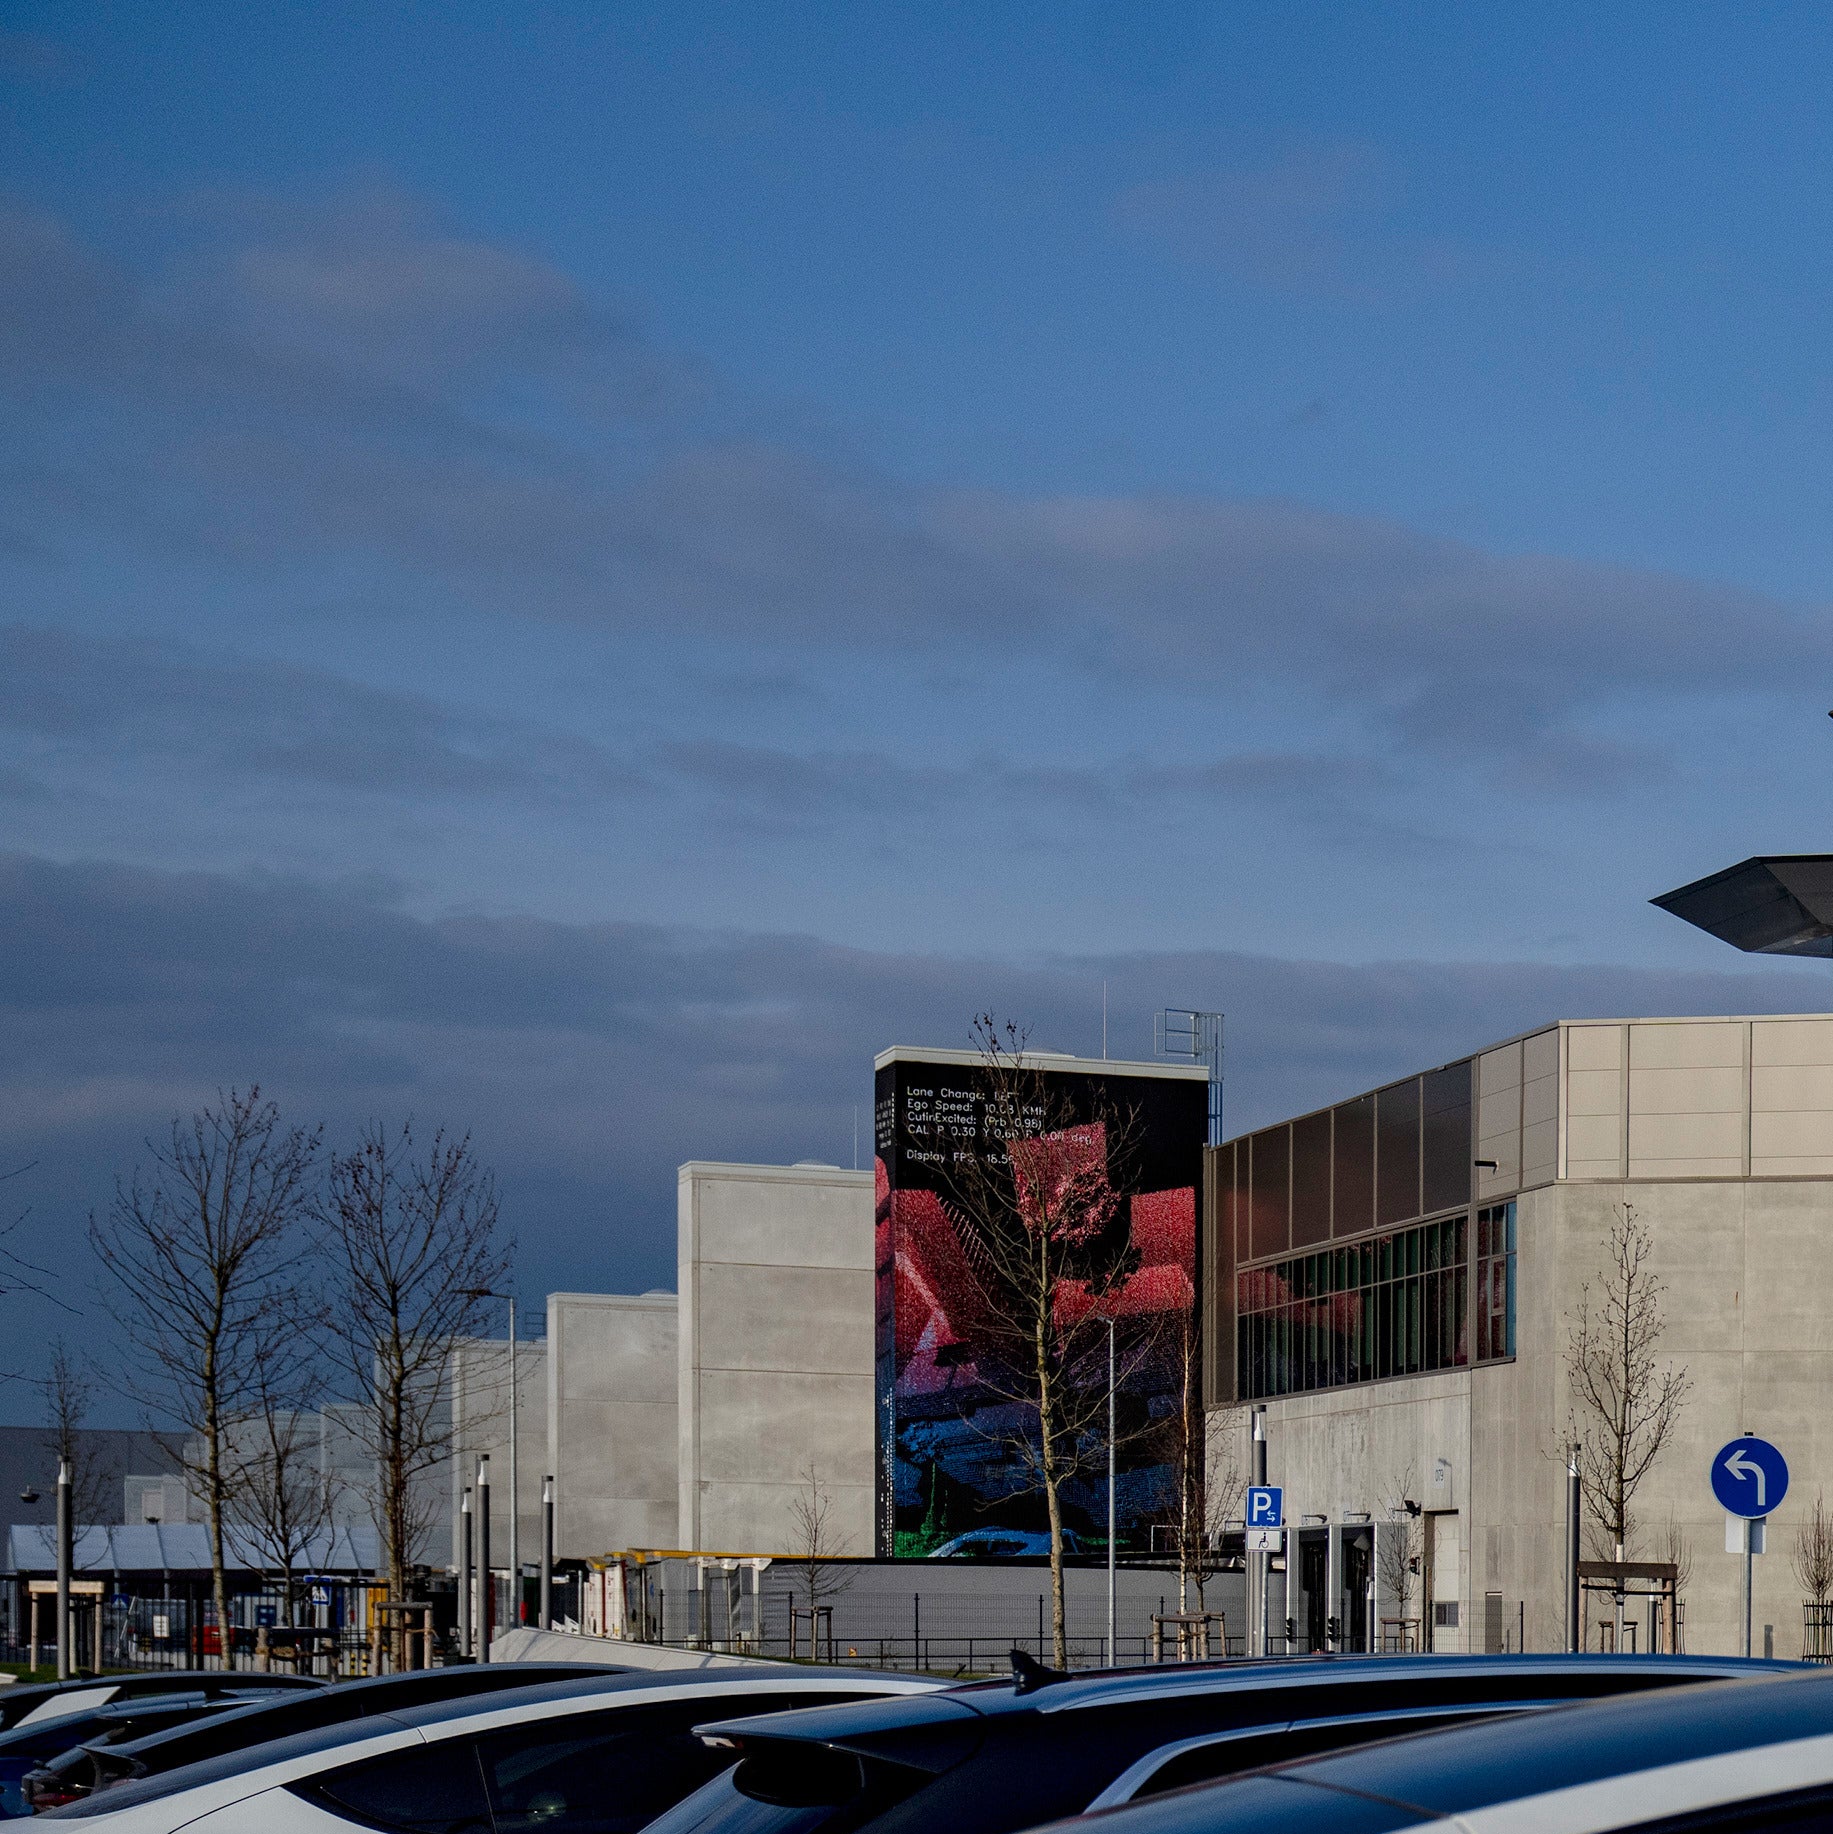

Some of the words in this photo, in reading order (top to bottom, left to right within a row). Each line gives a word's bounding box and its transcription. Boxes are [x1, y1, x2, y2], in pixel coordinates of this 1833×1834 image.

[907, 1086, 934, 1097] Lane
[907, 1098, 928, 1111] Ego
[935, 1100, 973, 1112] Speed:
[907, 1124, 929, 1135] CAL
[937, 1125, 944, 1134] P
[951, 1126, 976, 1137] 0.30
[983, 1128, 990, 1137] Y
[907, 1149, 946, 1163] Display
[1252, 1492, 1272, 1522] P
